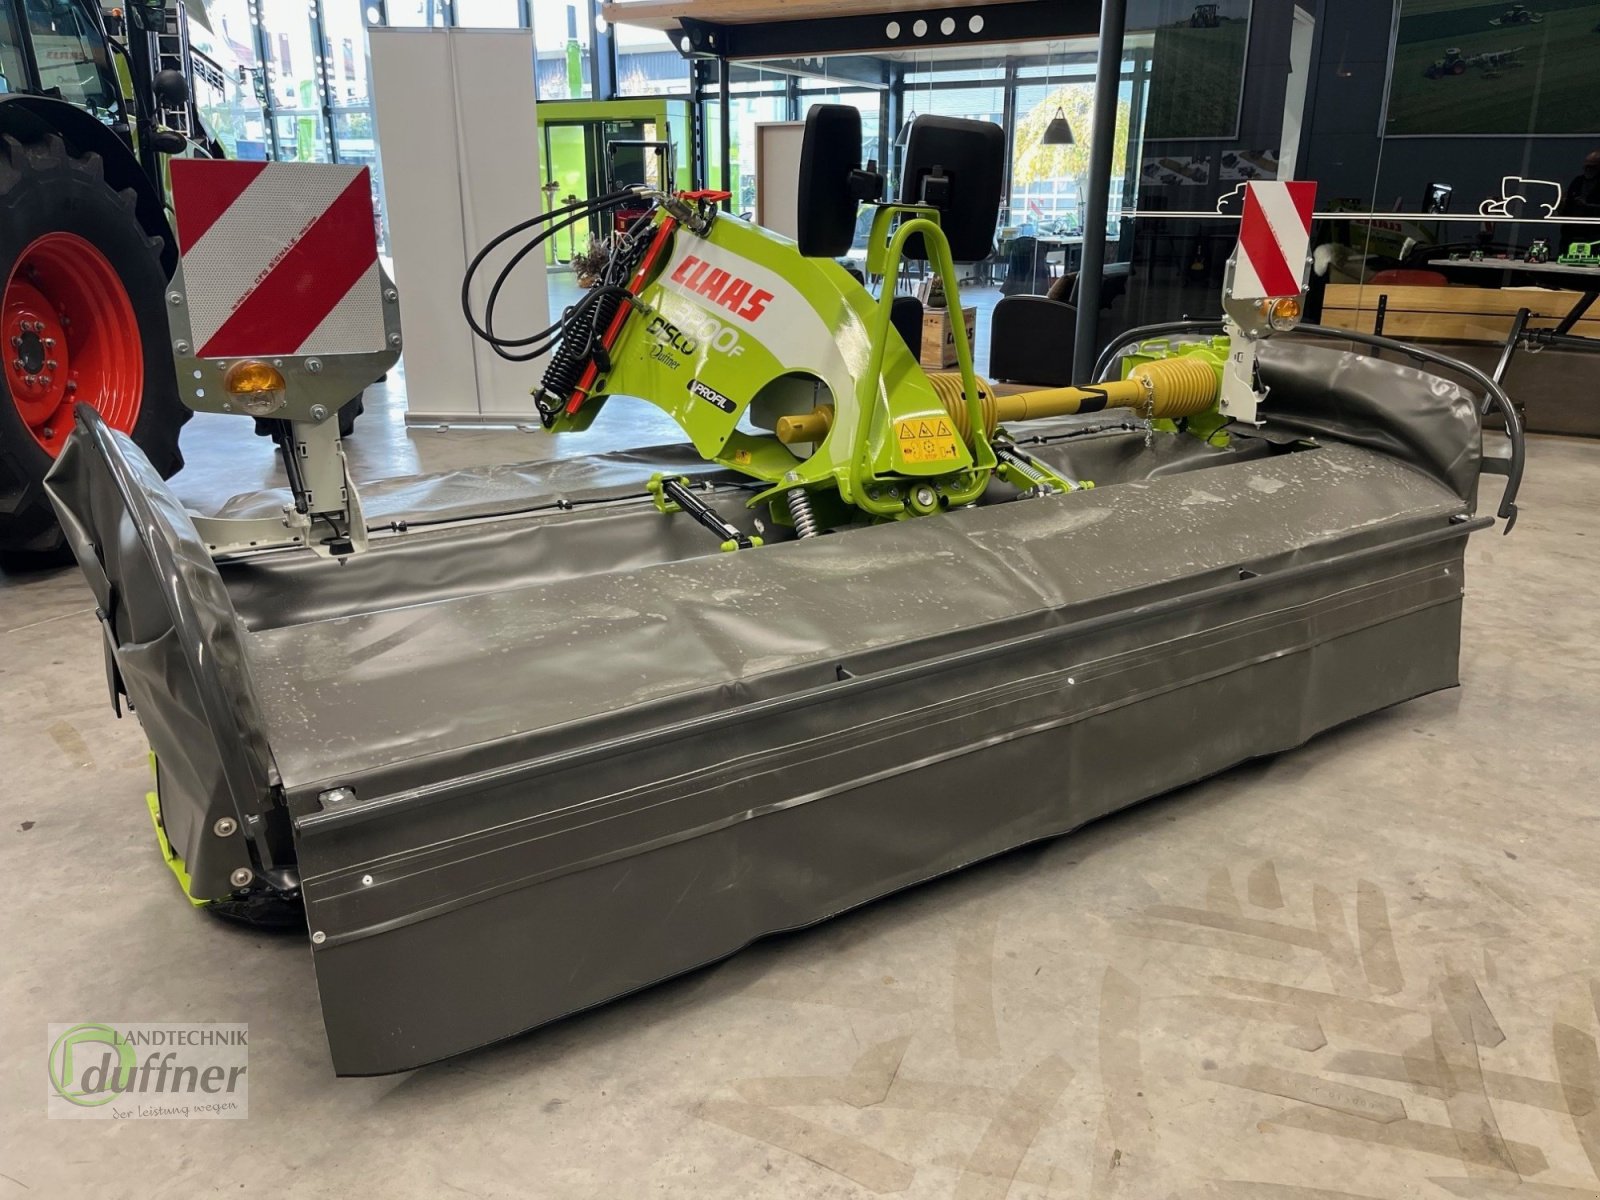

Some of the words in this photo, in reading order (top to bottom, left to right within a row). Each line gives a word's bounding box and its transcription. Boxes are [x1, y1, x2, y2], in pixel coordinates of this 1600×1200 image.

[670, 255, 775, 322] CLAAS
[646, 317, 698, 355] DISCO
[693, 382, 726, 409] PROFIL
